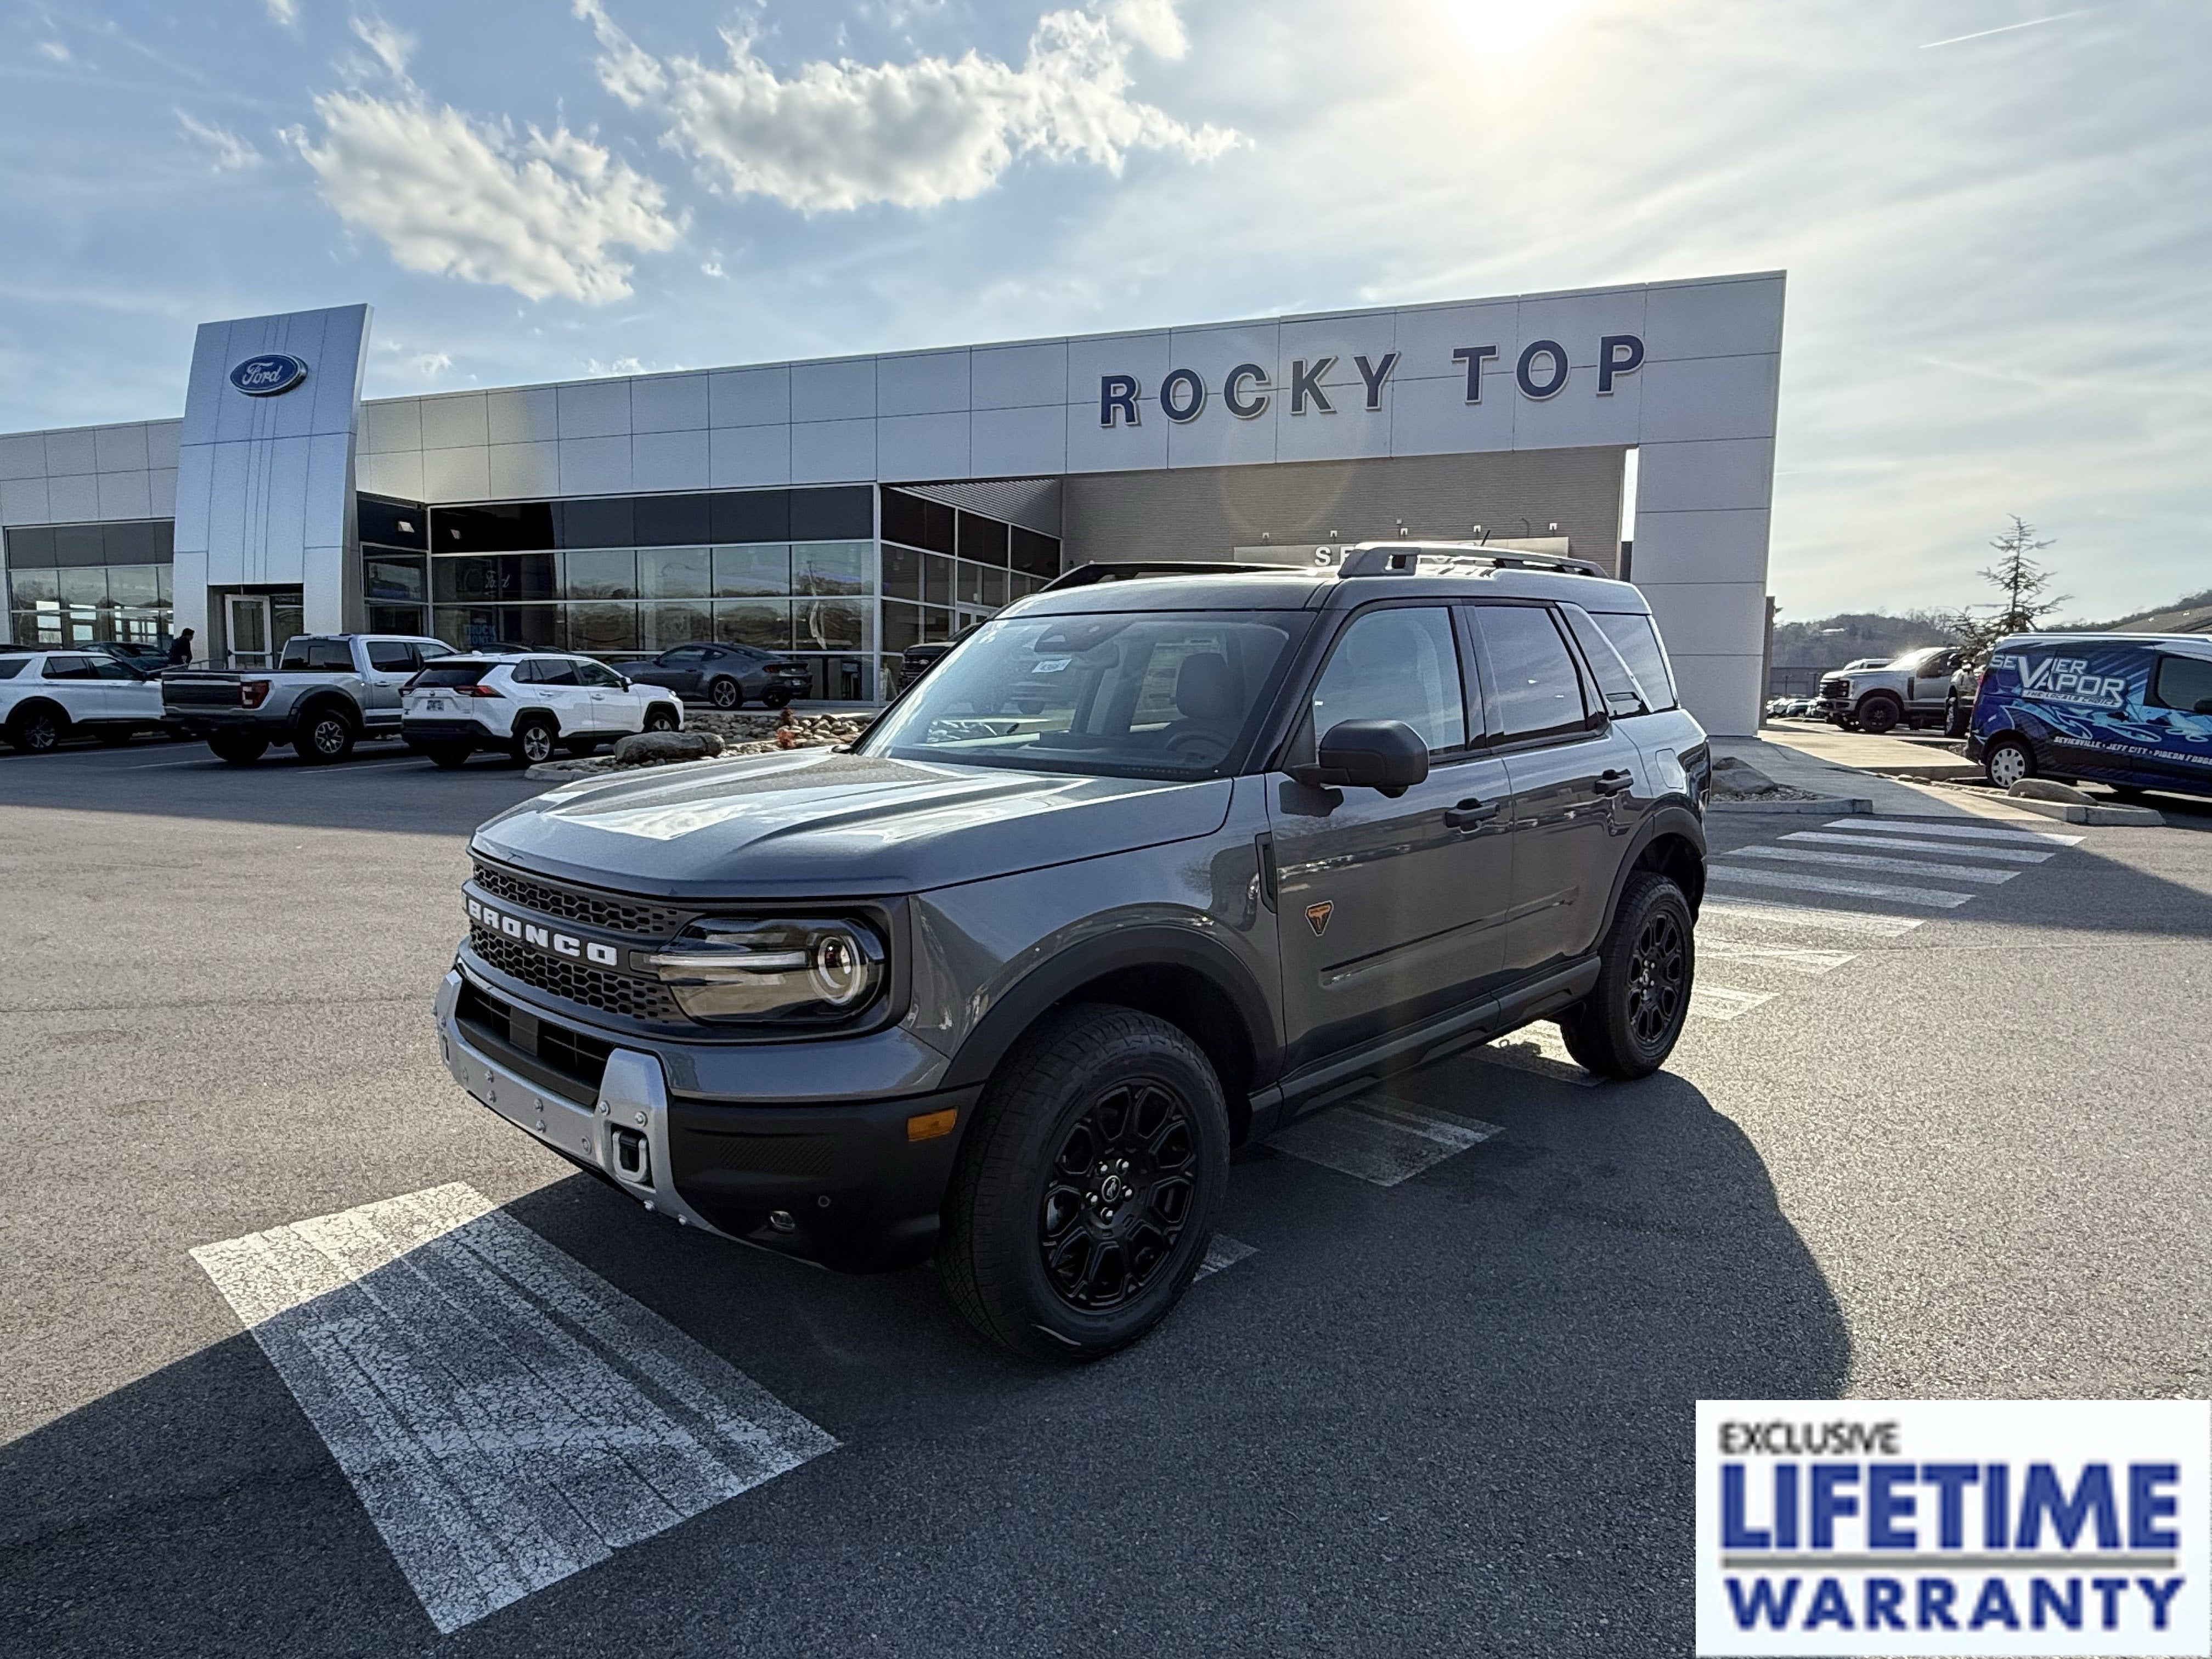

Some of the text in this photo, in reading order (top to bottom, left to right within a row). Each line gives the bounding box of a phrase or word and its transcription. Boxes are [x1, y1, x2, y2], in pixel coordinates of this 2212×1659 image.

[242, 362, 283, 385] Ford
[1099, 333, 1645, 427] ROCKY TOP
[2018, 656, 2125, 708] VAPOR
[2106, 742, 2129, 752] JEFF
[2128, 746, 2148, 754] CITY
[469, 899, 618, 967] BRONCO
